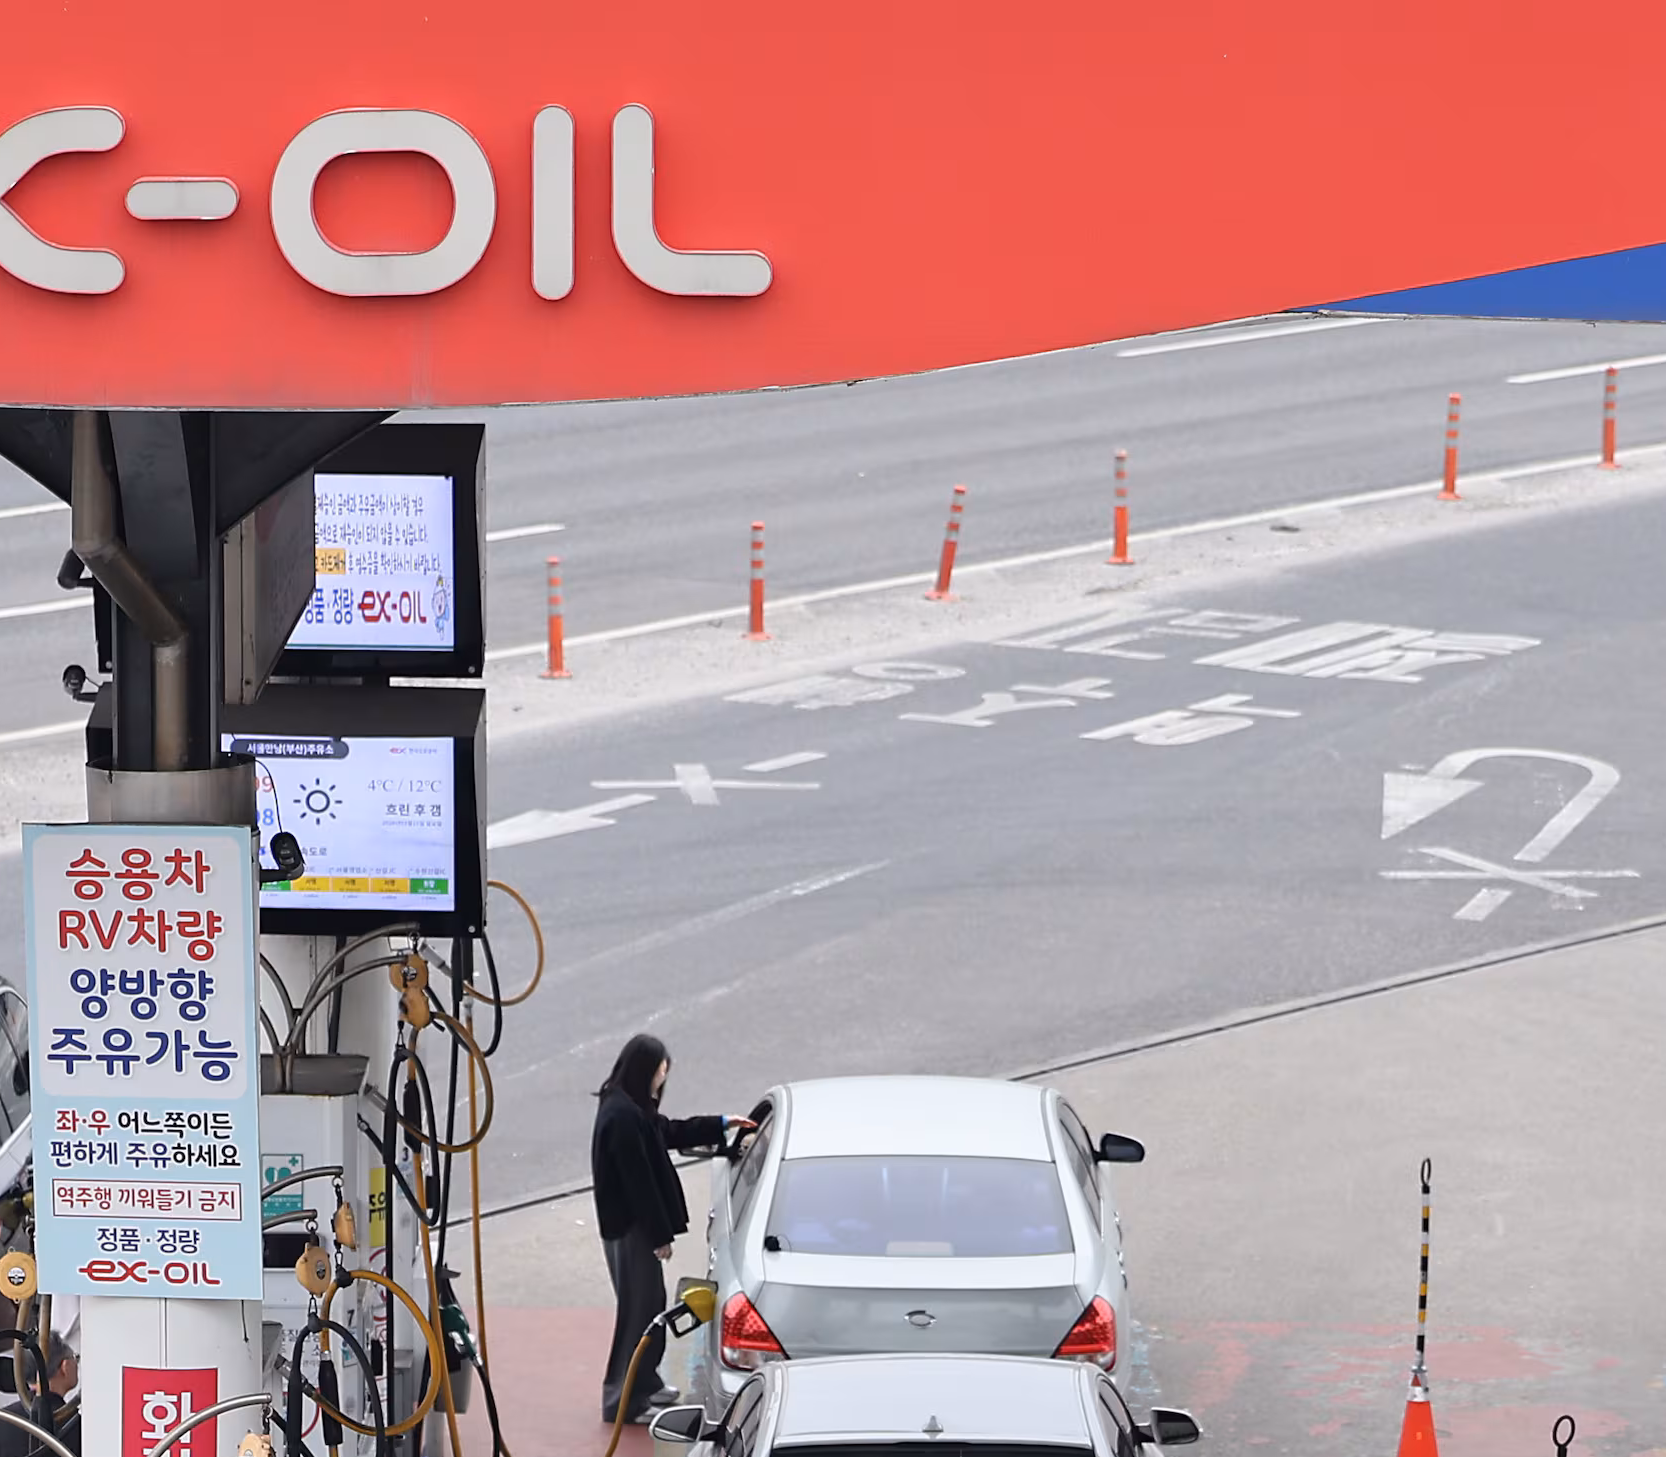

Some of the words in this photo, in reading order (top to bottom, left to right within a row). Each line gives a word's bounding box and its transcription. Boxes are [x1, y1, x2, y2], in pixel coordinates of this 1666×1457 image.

[333, 588, 354, 624] 정량
[386, 804, 410, 817] 흐린
[414, 804, 426, 817] 후
[66, 849, 211, 900] 승용차
[59, 908, 223, 961] RV차량
[70, 968, 214, 1021] 양방향
[47, 1028, 239, 1081] 주유가능
[118, 1111, 233, 1141] 어느쪽이든
[51, 1141, 118, 1168] 편하게
[125, 1142, 241, 1168] 주유하세요
[57, 1187, 112, 1211] 역주행
[118, 1188, 193, 1211] 끼워들기
[198, 1190, 235, 1212] 금지
[97, 1228, 140, 1252] 정품
[157, 1229, 200, 1254] 정량
